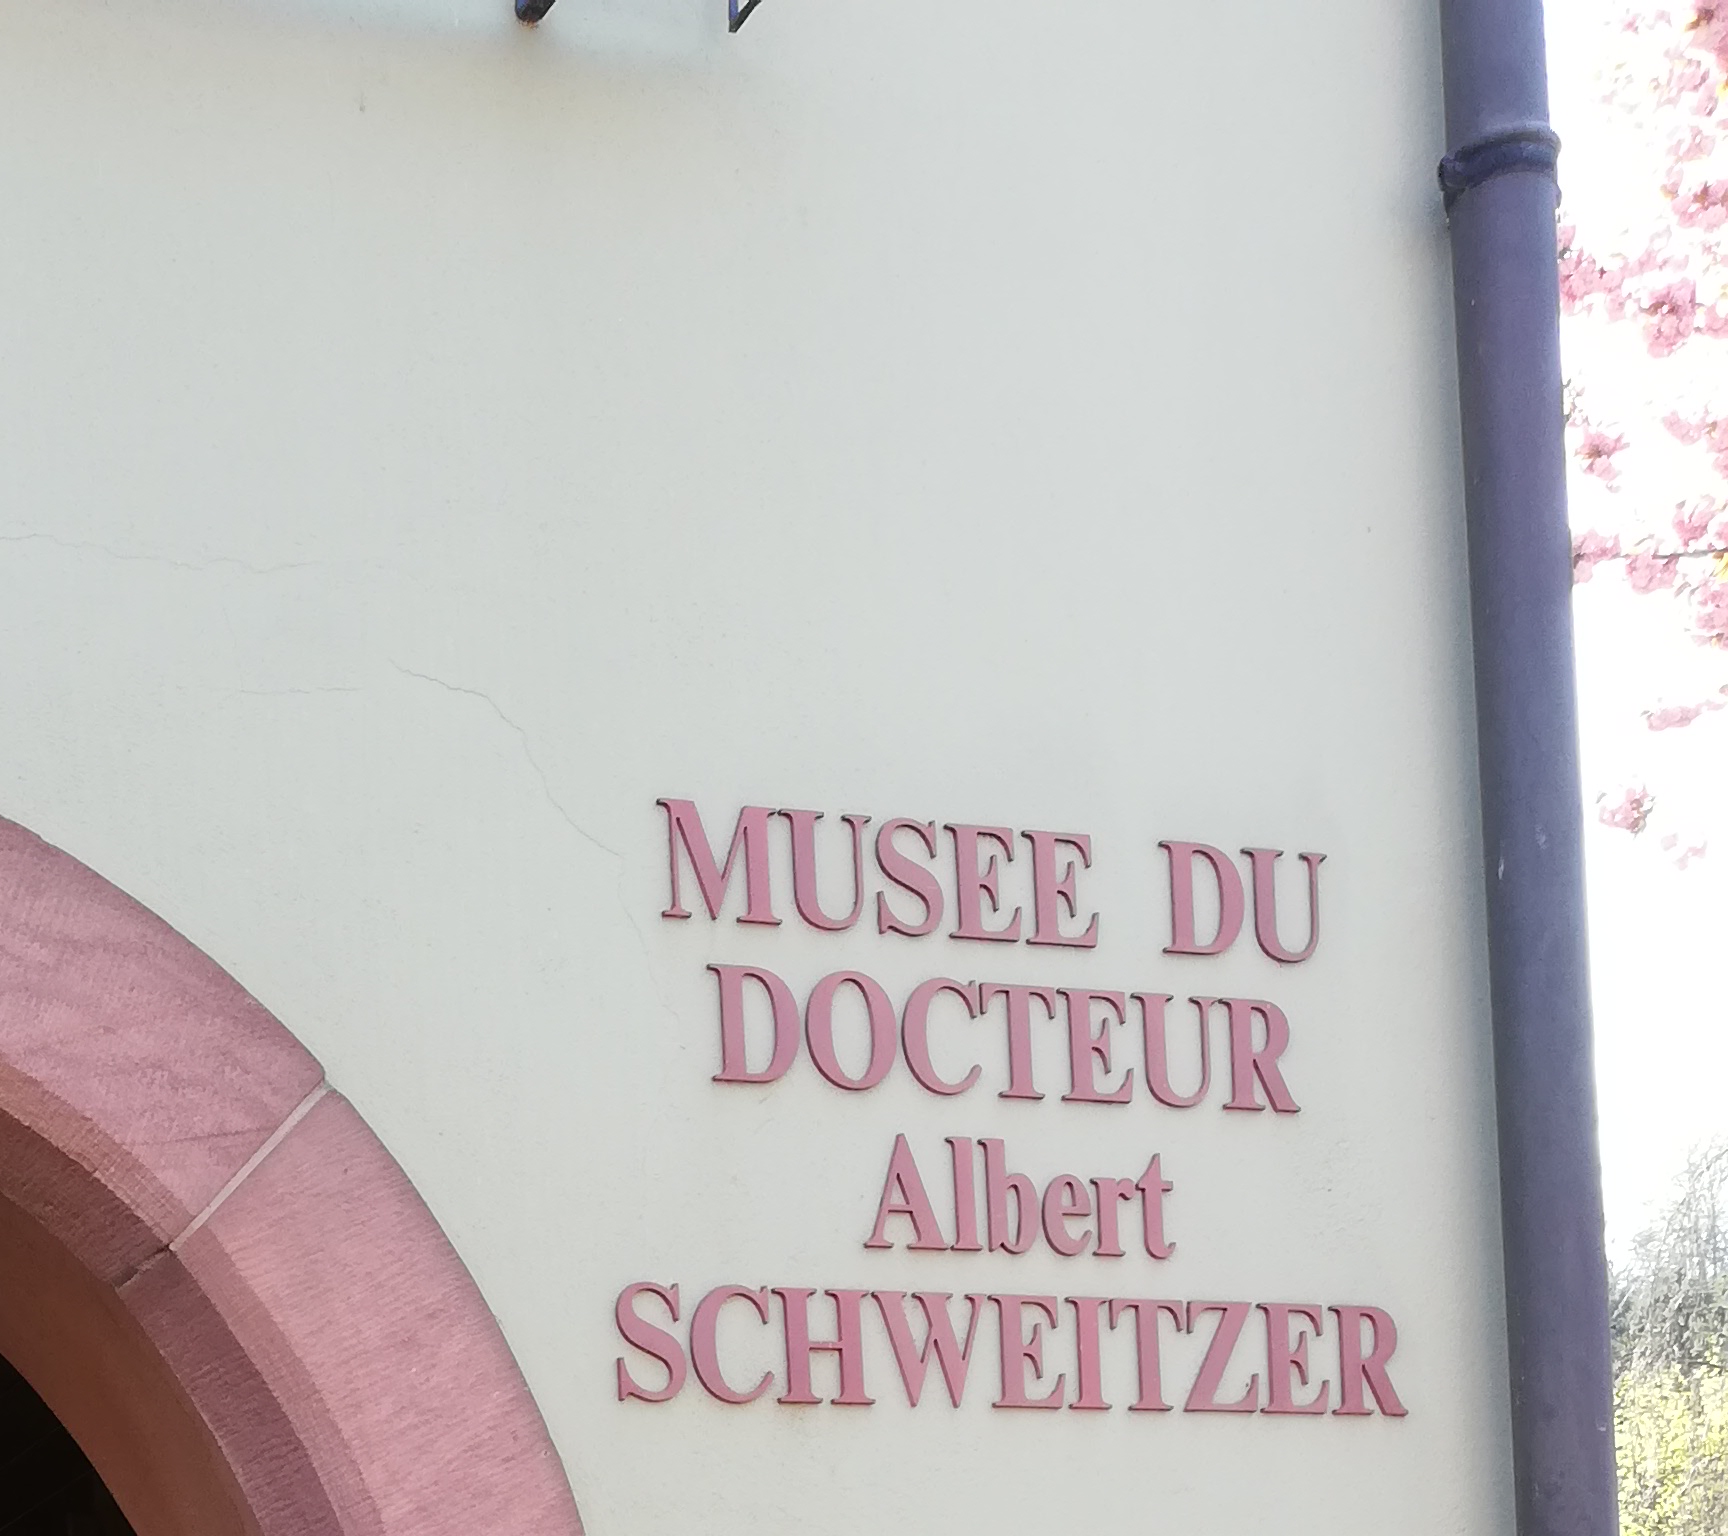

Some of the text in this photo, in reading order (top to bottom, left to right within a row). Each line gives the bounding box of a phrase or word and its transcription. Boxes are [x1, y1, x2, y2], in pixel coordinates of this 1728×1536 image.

[656, 798, 1327, 964] MUSEE DU
[706, 963, 1301, 1113] DOCTEUR
[864, 1134, 1176, 1260] Albert
[615, 1281, 1409, 1417] SCHWEITZER
